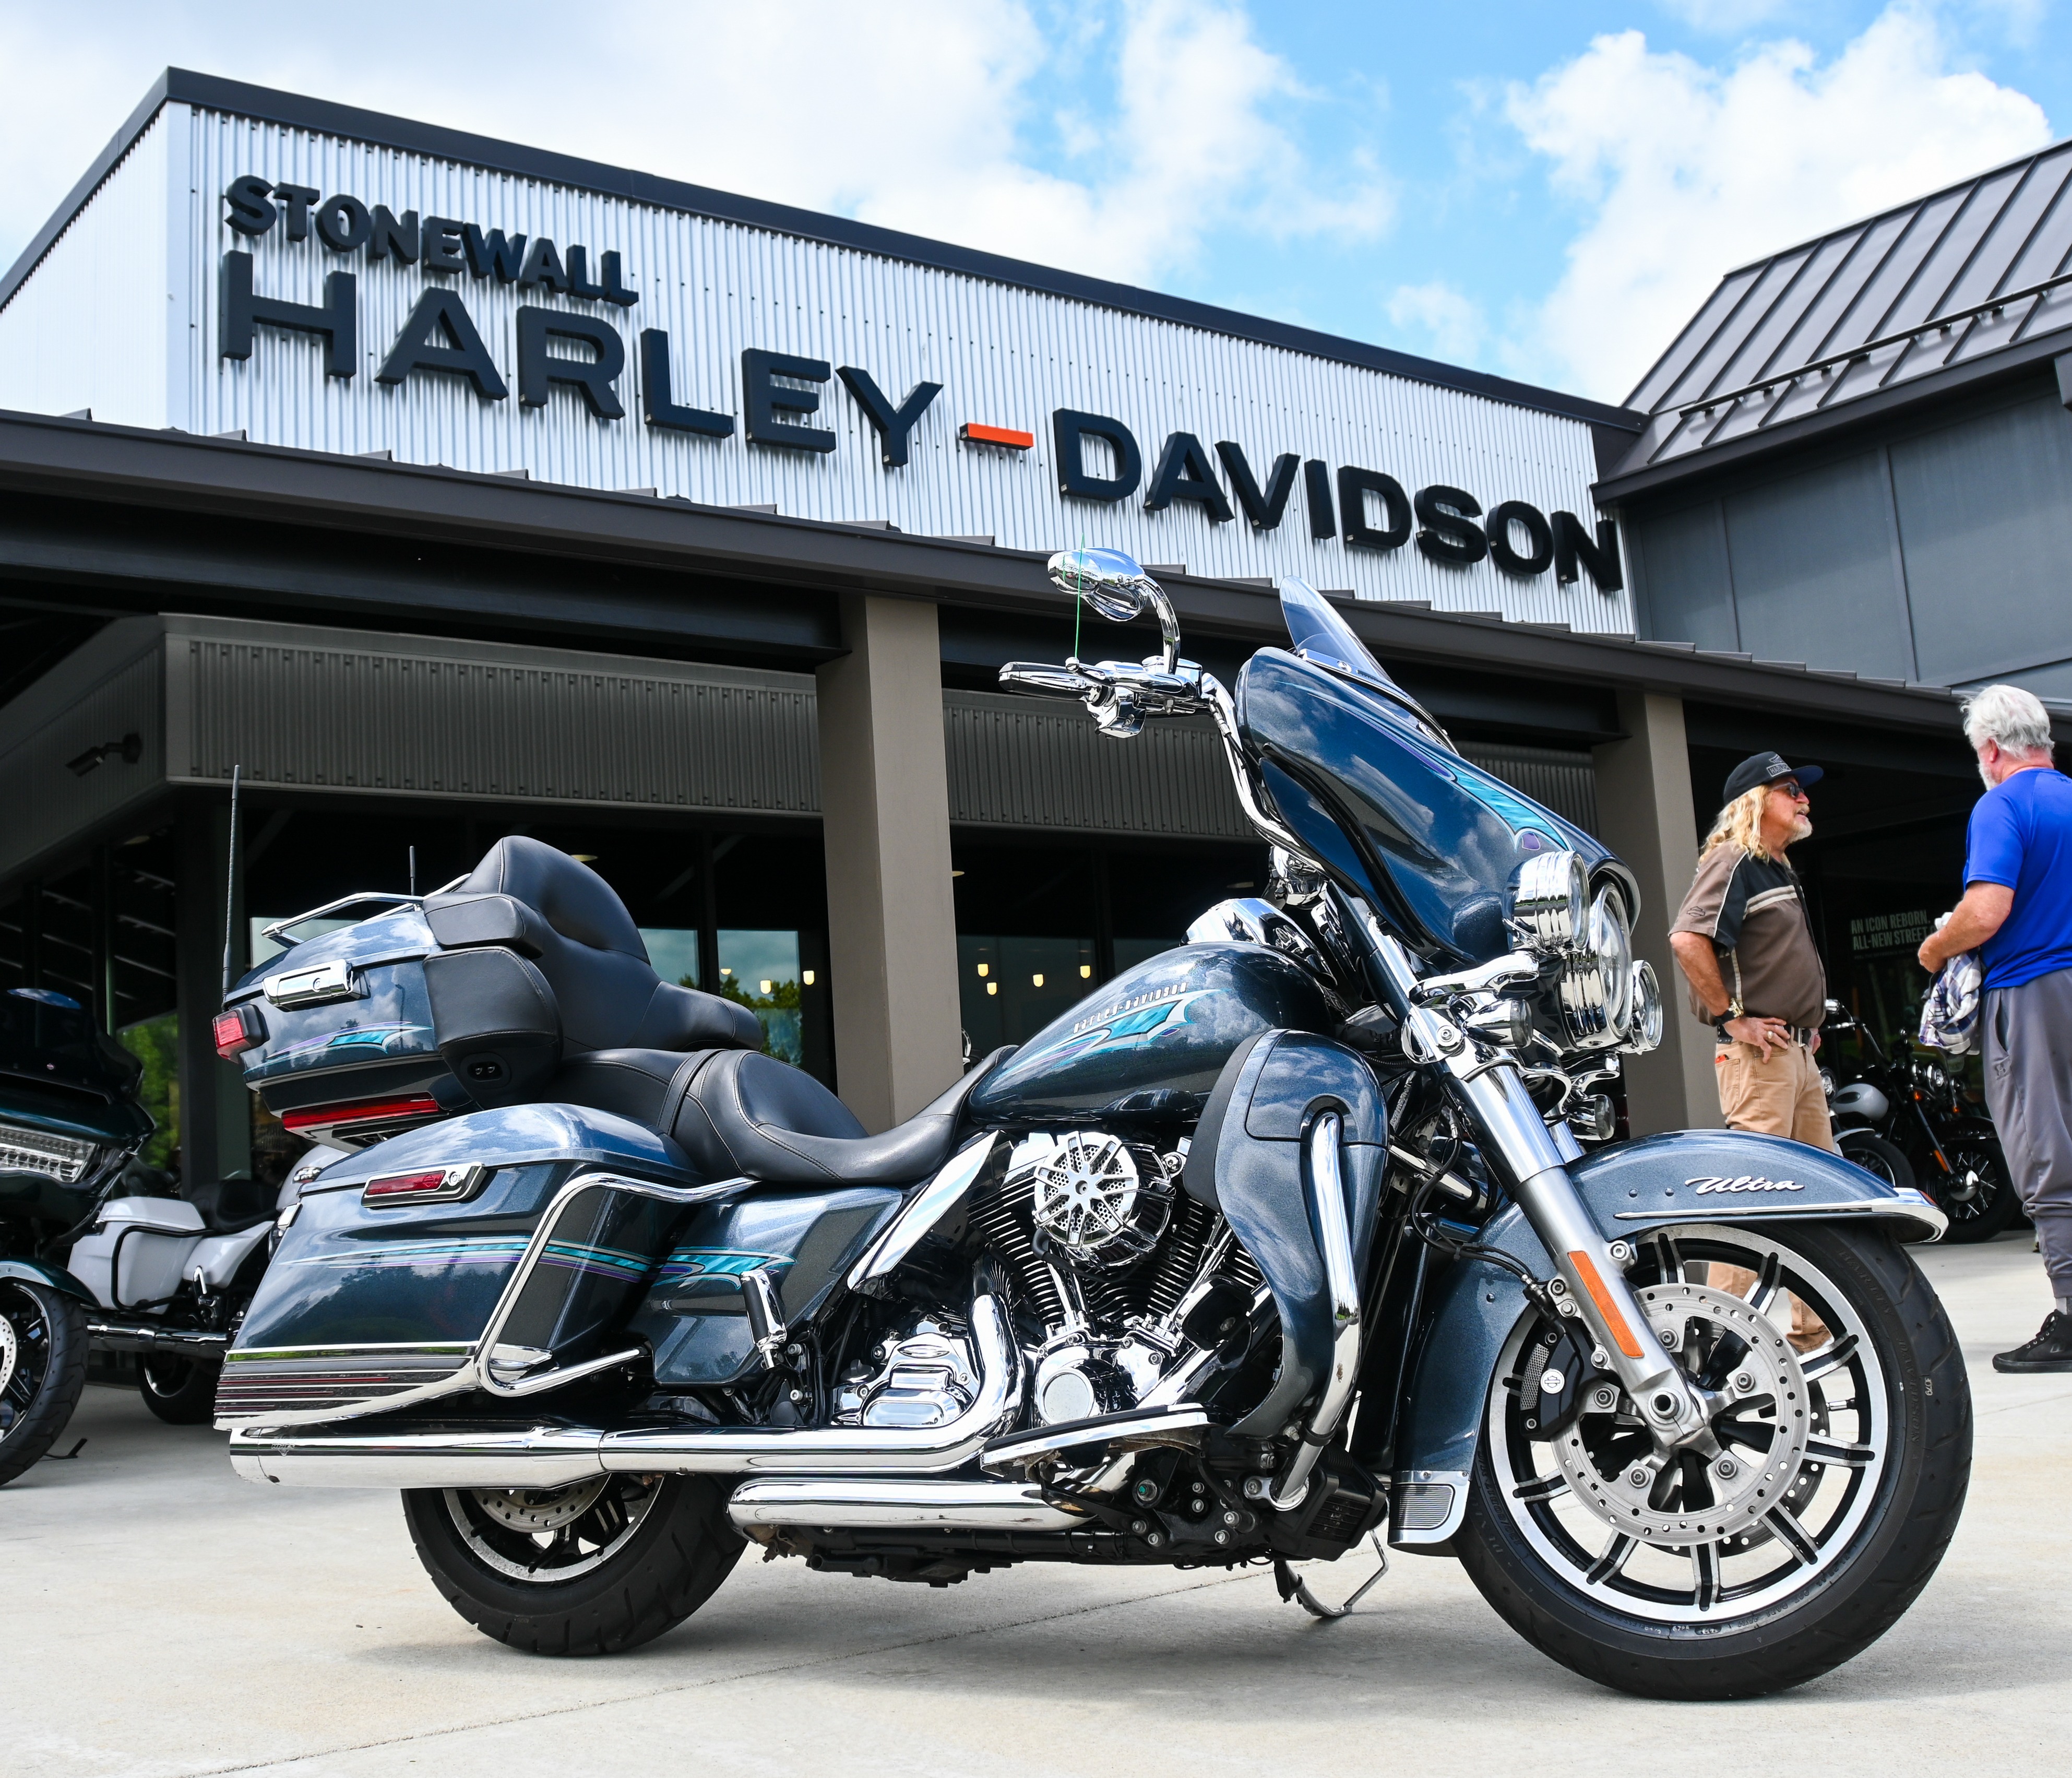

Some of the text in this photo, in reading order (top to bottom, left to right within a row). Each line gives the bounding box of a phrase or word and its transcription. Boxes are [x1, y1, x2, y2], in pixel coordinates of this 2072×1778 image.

[224, 174, 638, 306] STONEWALL
[1851, 909, 1931, 934] AN ICON REBORN.
[1853, 932, 1892, 950] ALL-NEW
[1894, 926, 1927, 945] STREET
[1685, 1176, 1805, 1195] Ultra
